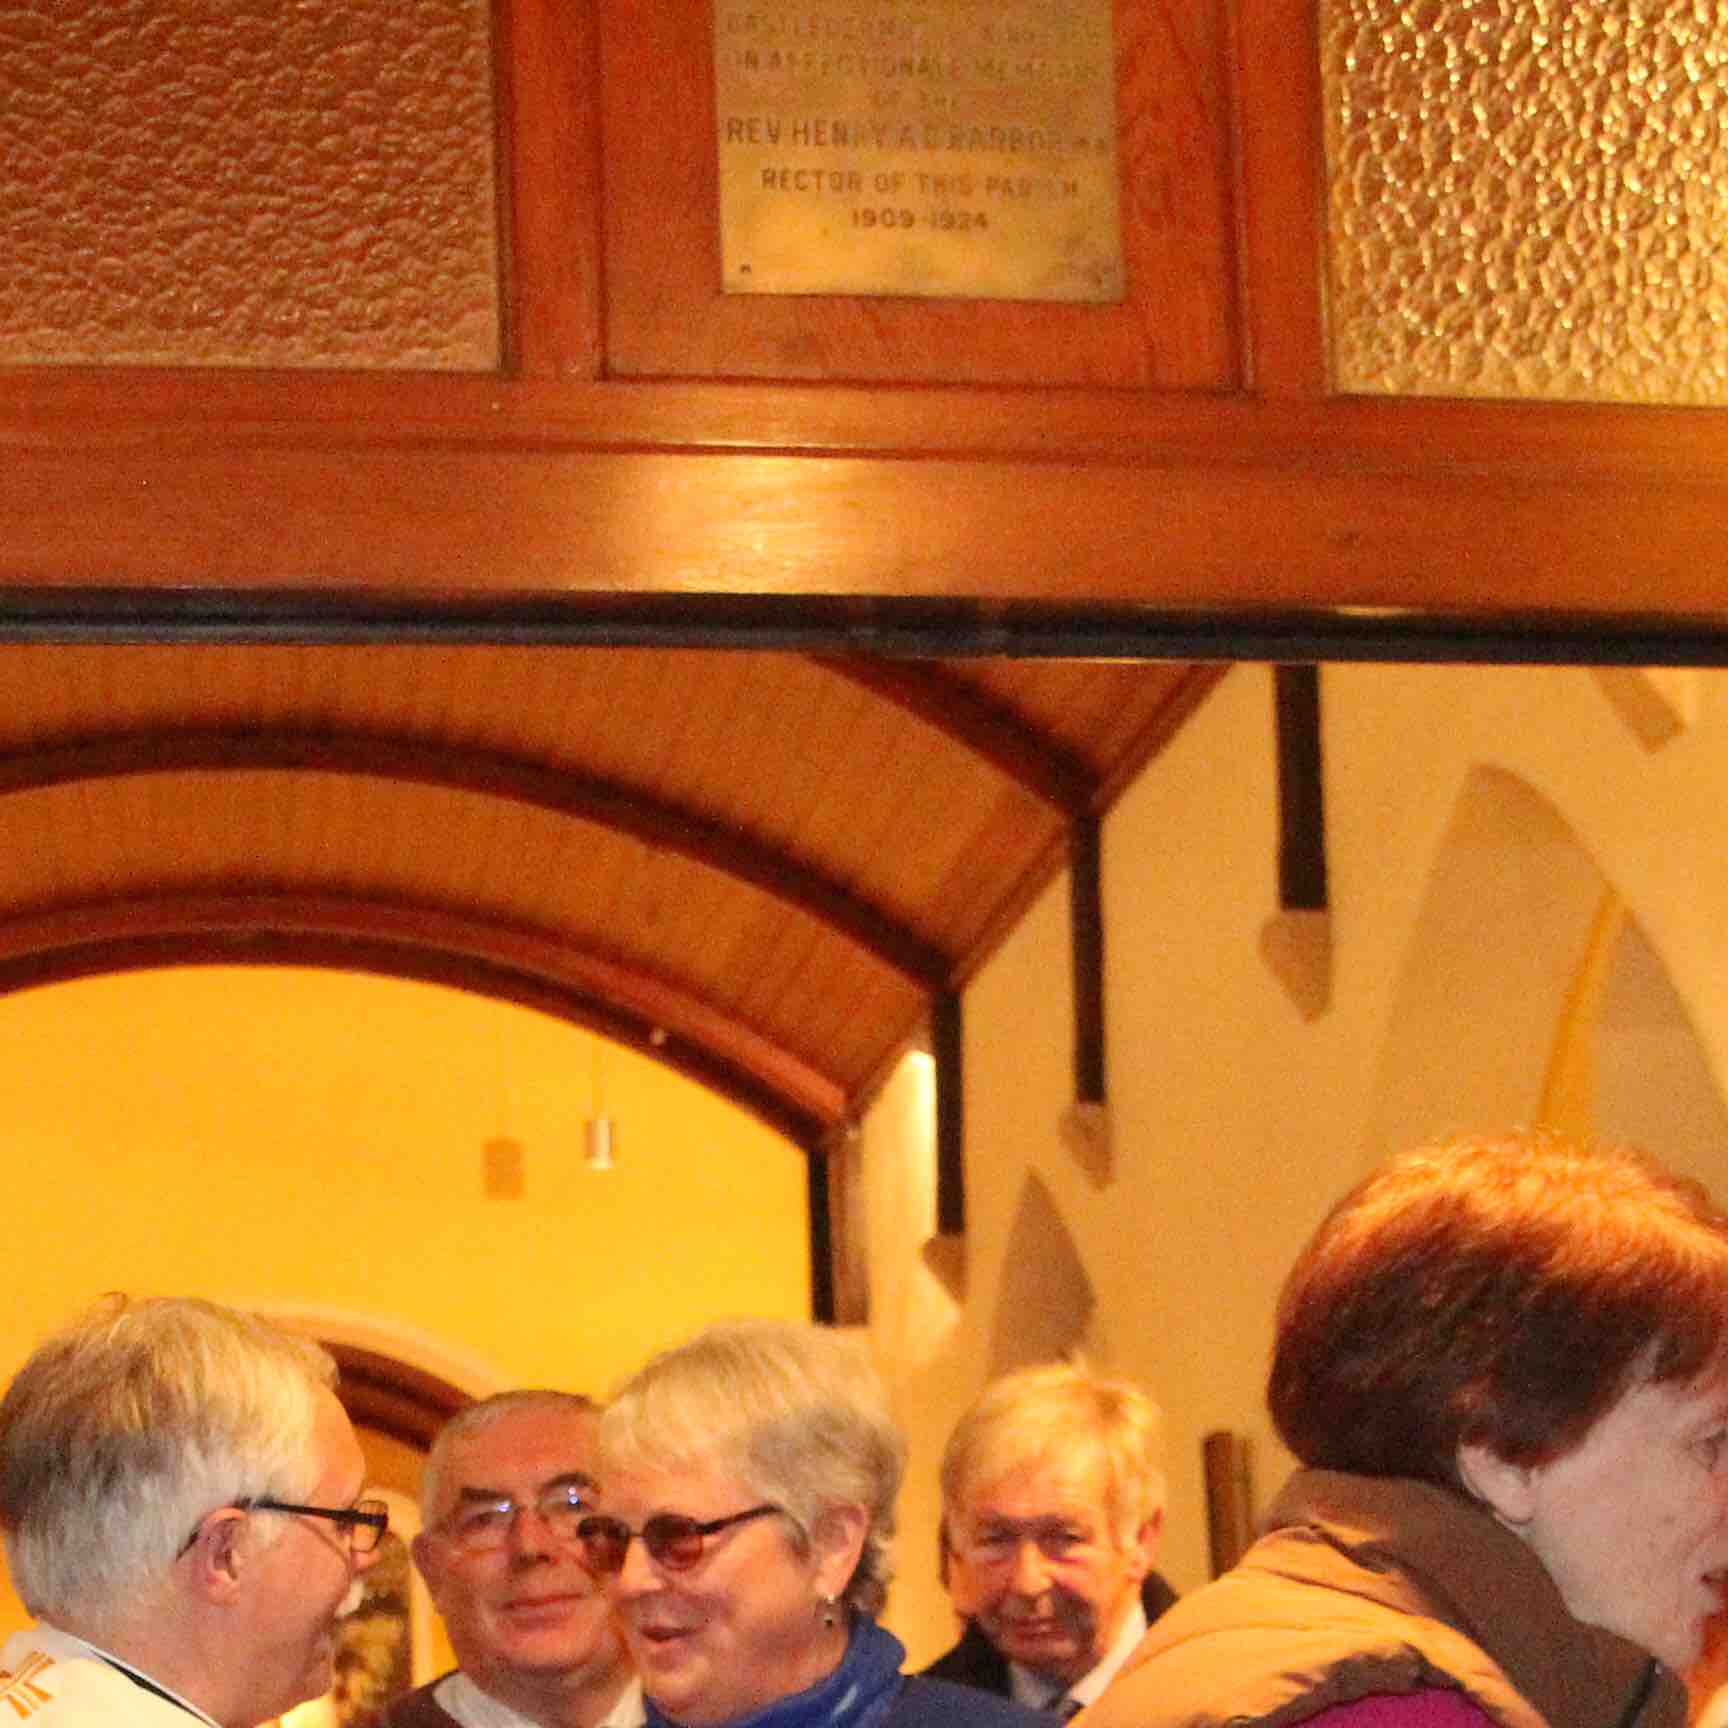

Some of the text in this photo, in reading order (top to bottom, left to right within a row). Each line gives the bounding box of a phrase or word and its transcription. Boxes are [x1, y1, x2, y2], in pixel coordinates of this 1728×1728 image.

[727, 116, 781, 145] REV
[760, 167, 1079, 199] RECTOR OF THIS PARH
